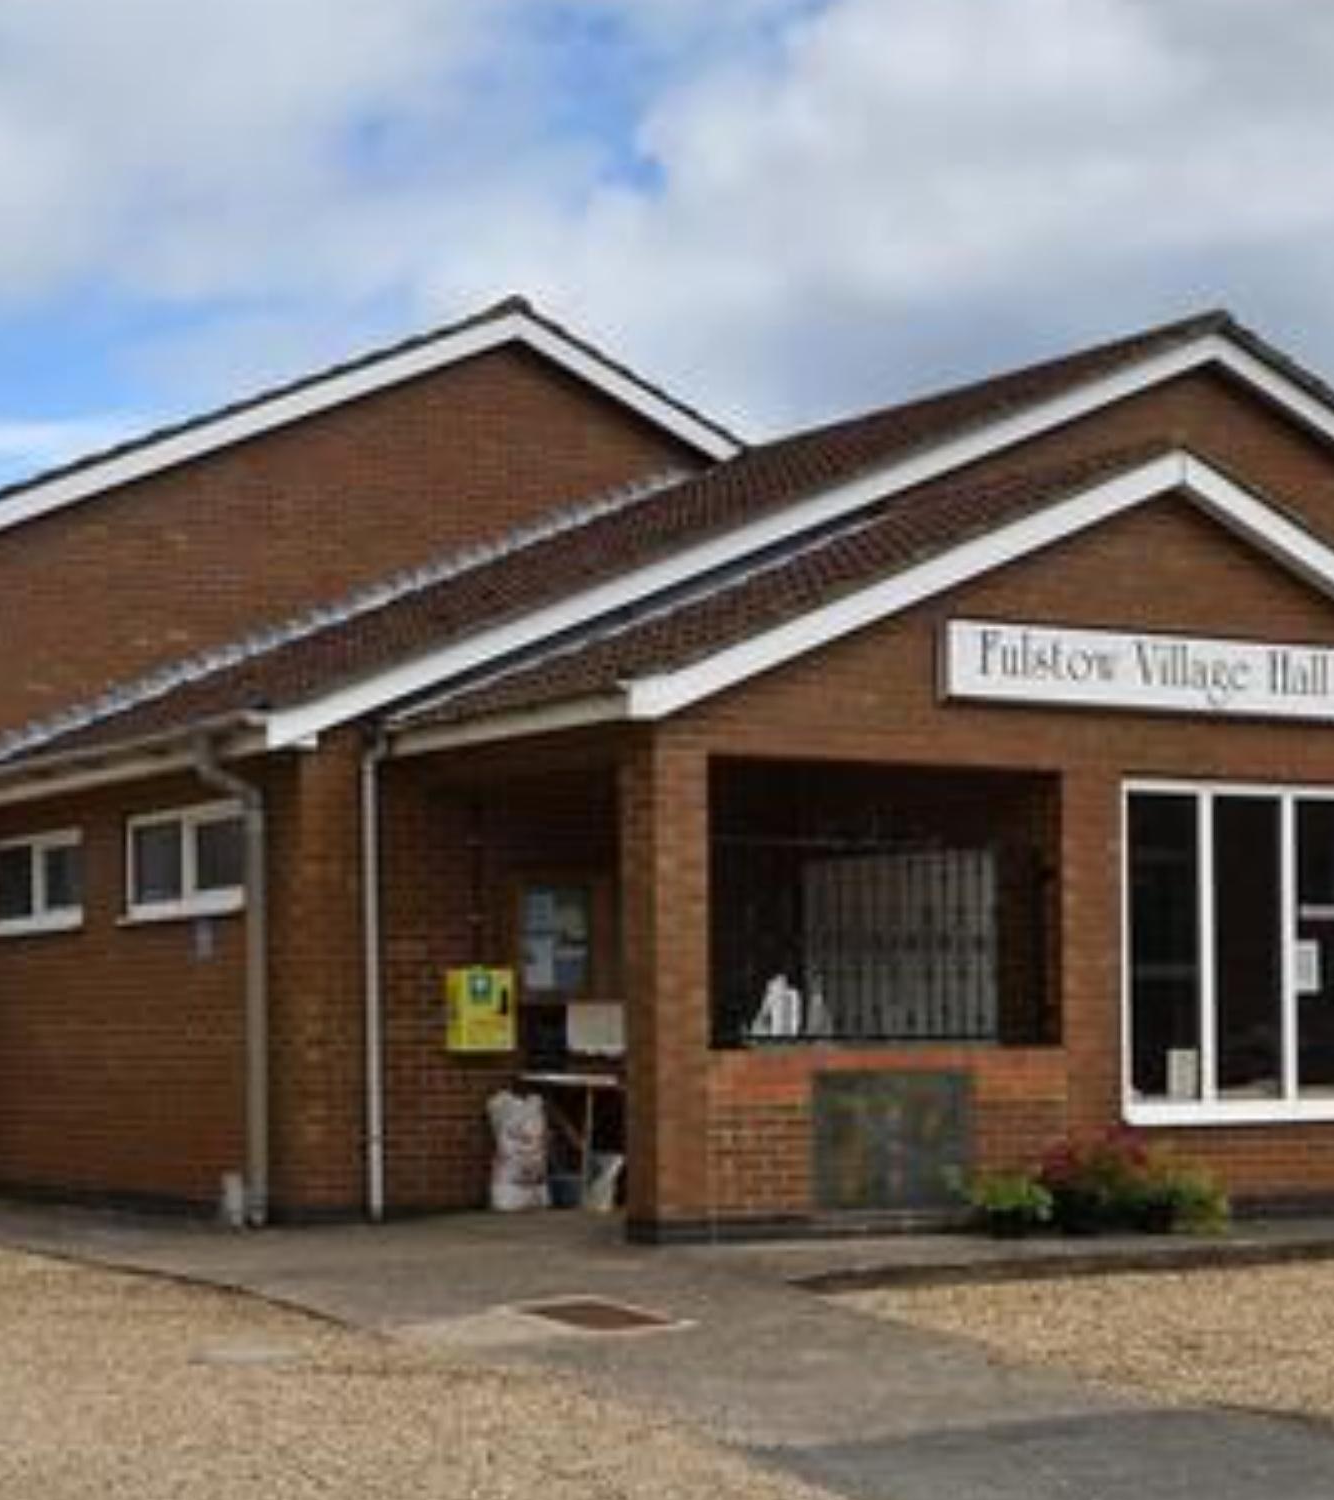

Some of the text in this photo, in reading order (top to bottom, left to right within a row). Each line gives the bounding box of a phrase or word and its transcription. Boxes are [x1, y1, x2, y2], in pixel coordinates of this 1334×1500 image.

[978, 630, 1328, 706] Fulstow Village Hall
